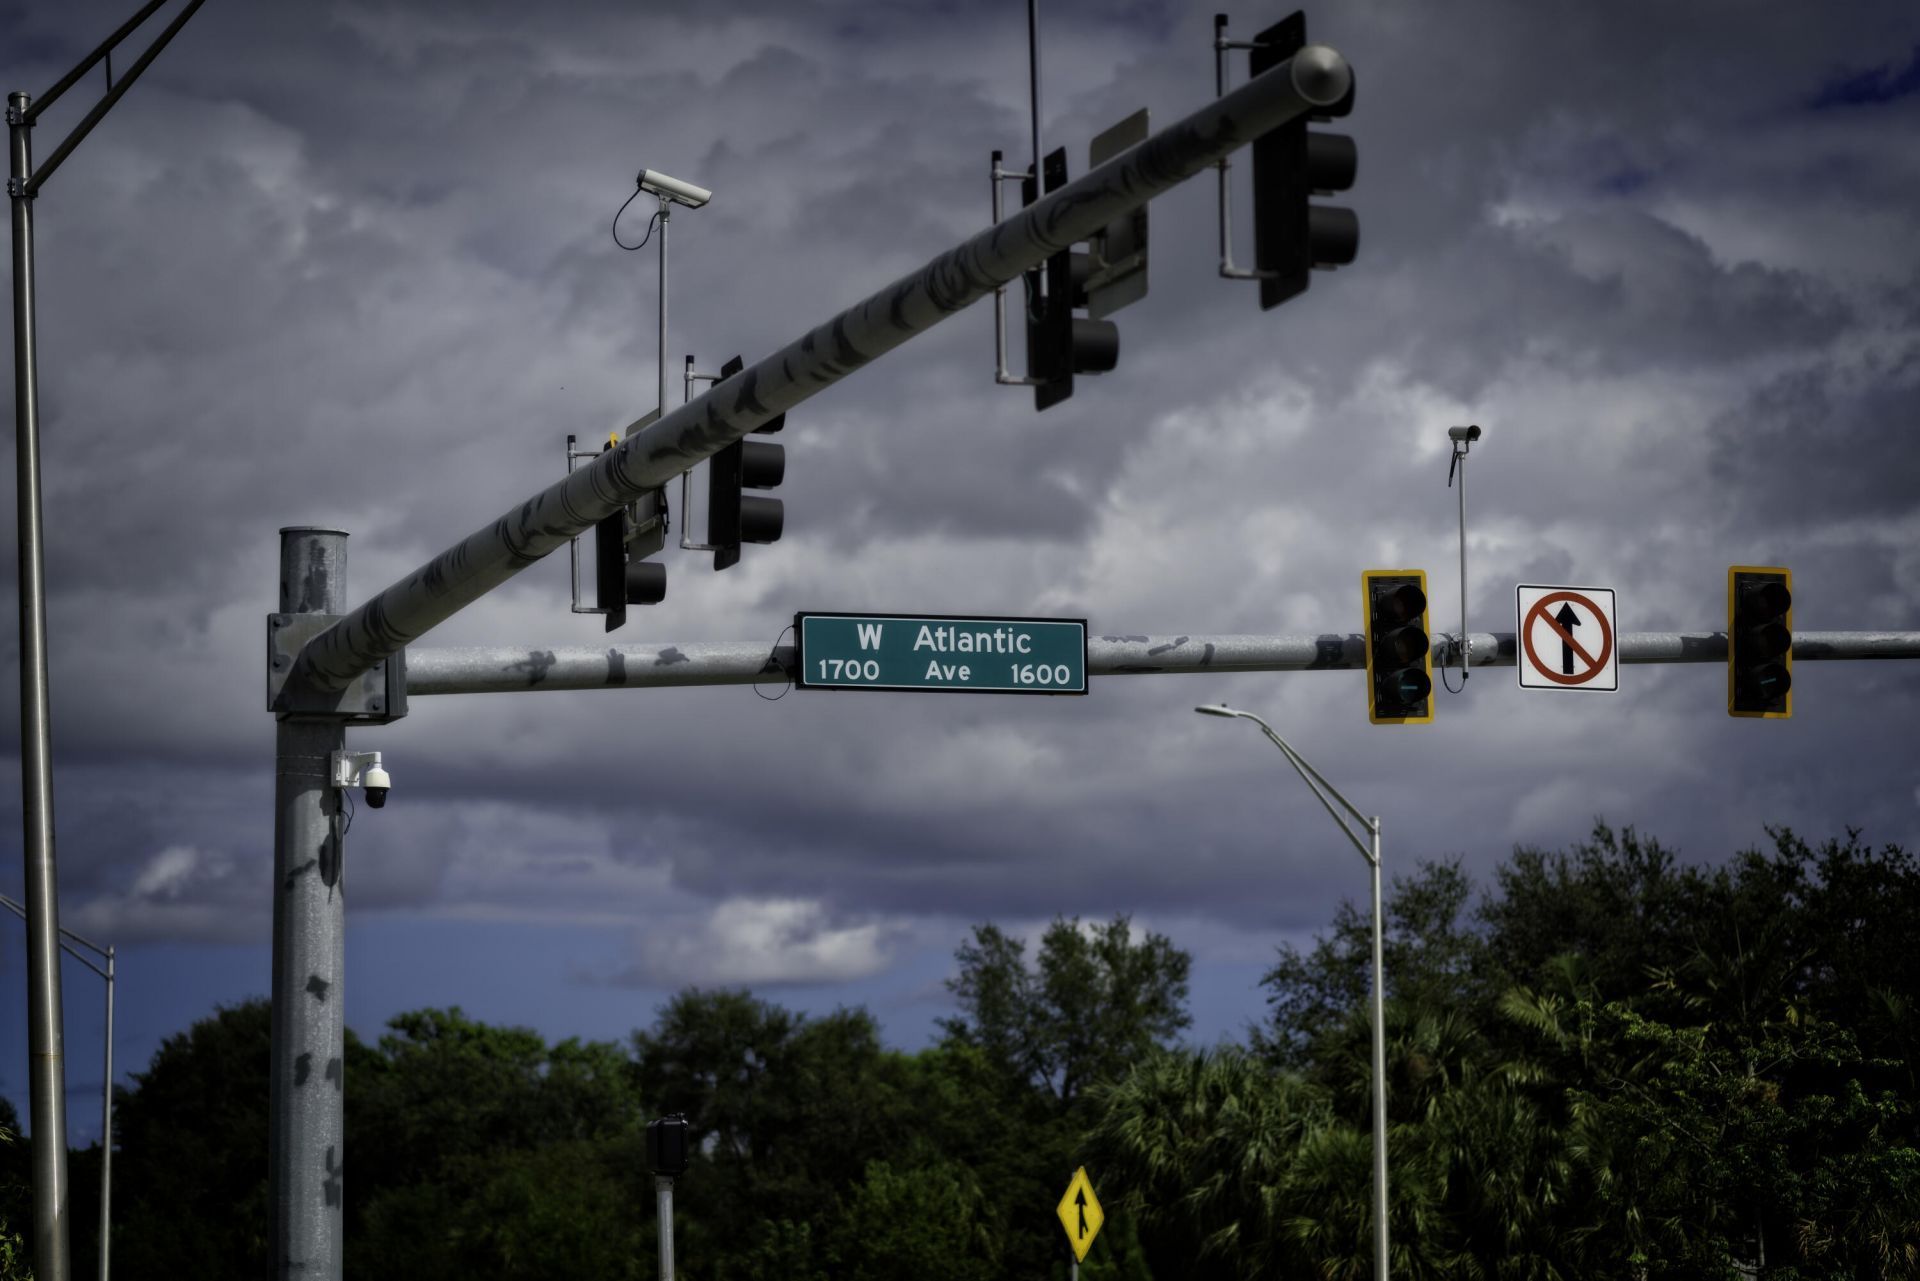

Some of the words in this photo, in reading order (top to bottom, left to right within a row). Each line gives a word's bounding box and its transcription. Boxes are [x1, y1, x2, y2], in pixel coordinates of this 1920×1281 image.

[857, 624, 883, 650] W
[913, 625, 1031, 653] Atlantic
[819, 659, 880, 680] 1700
[925, 660, 971, 681] Ave
[1011, 663, 1070, 685] 1600
